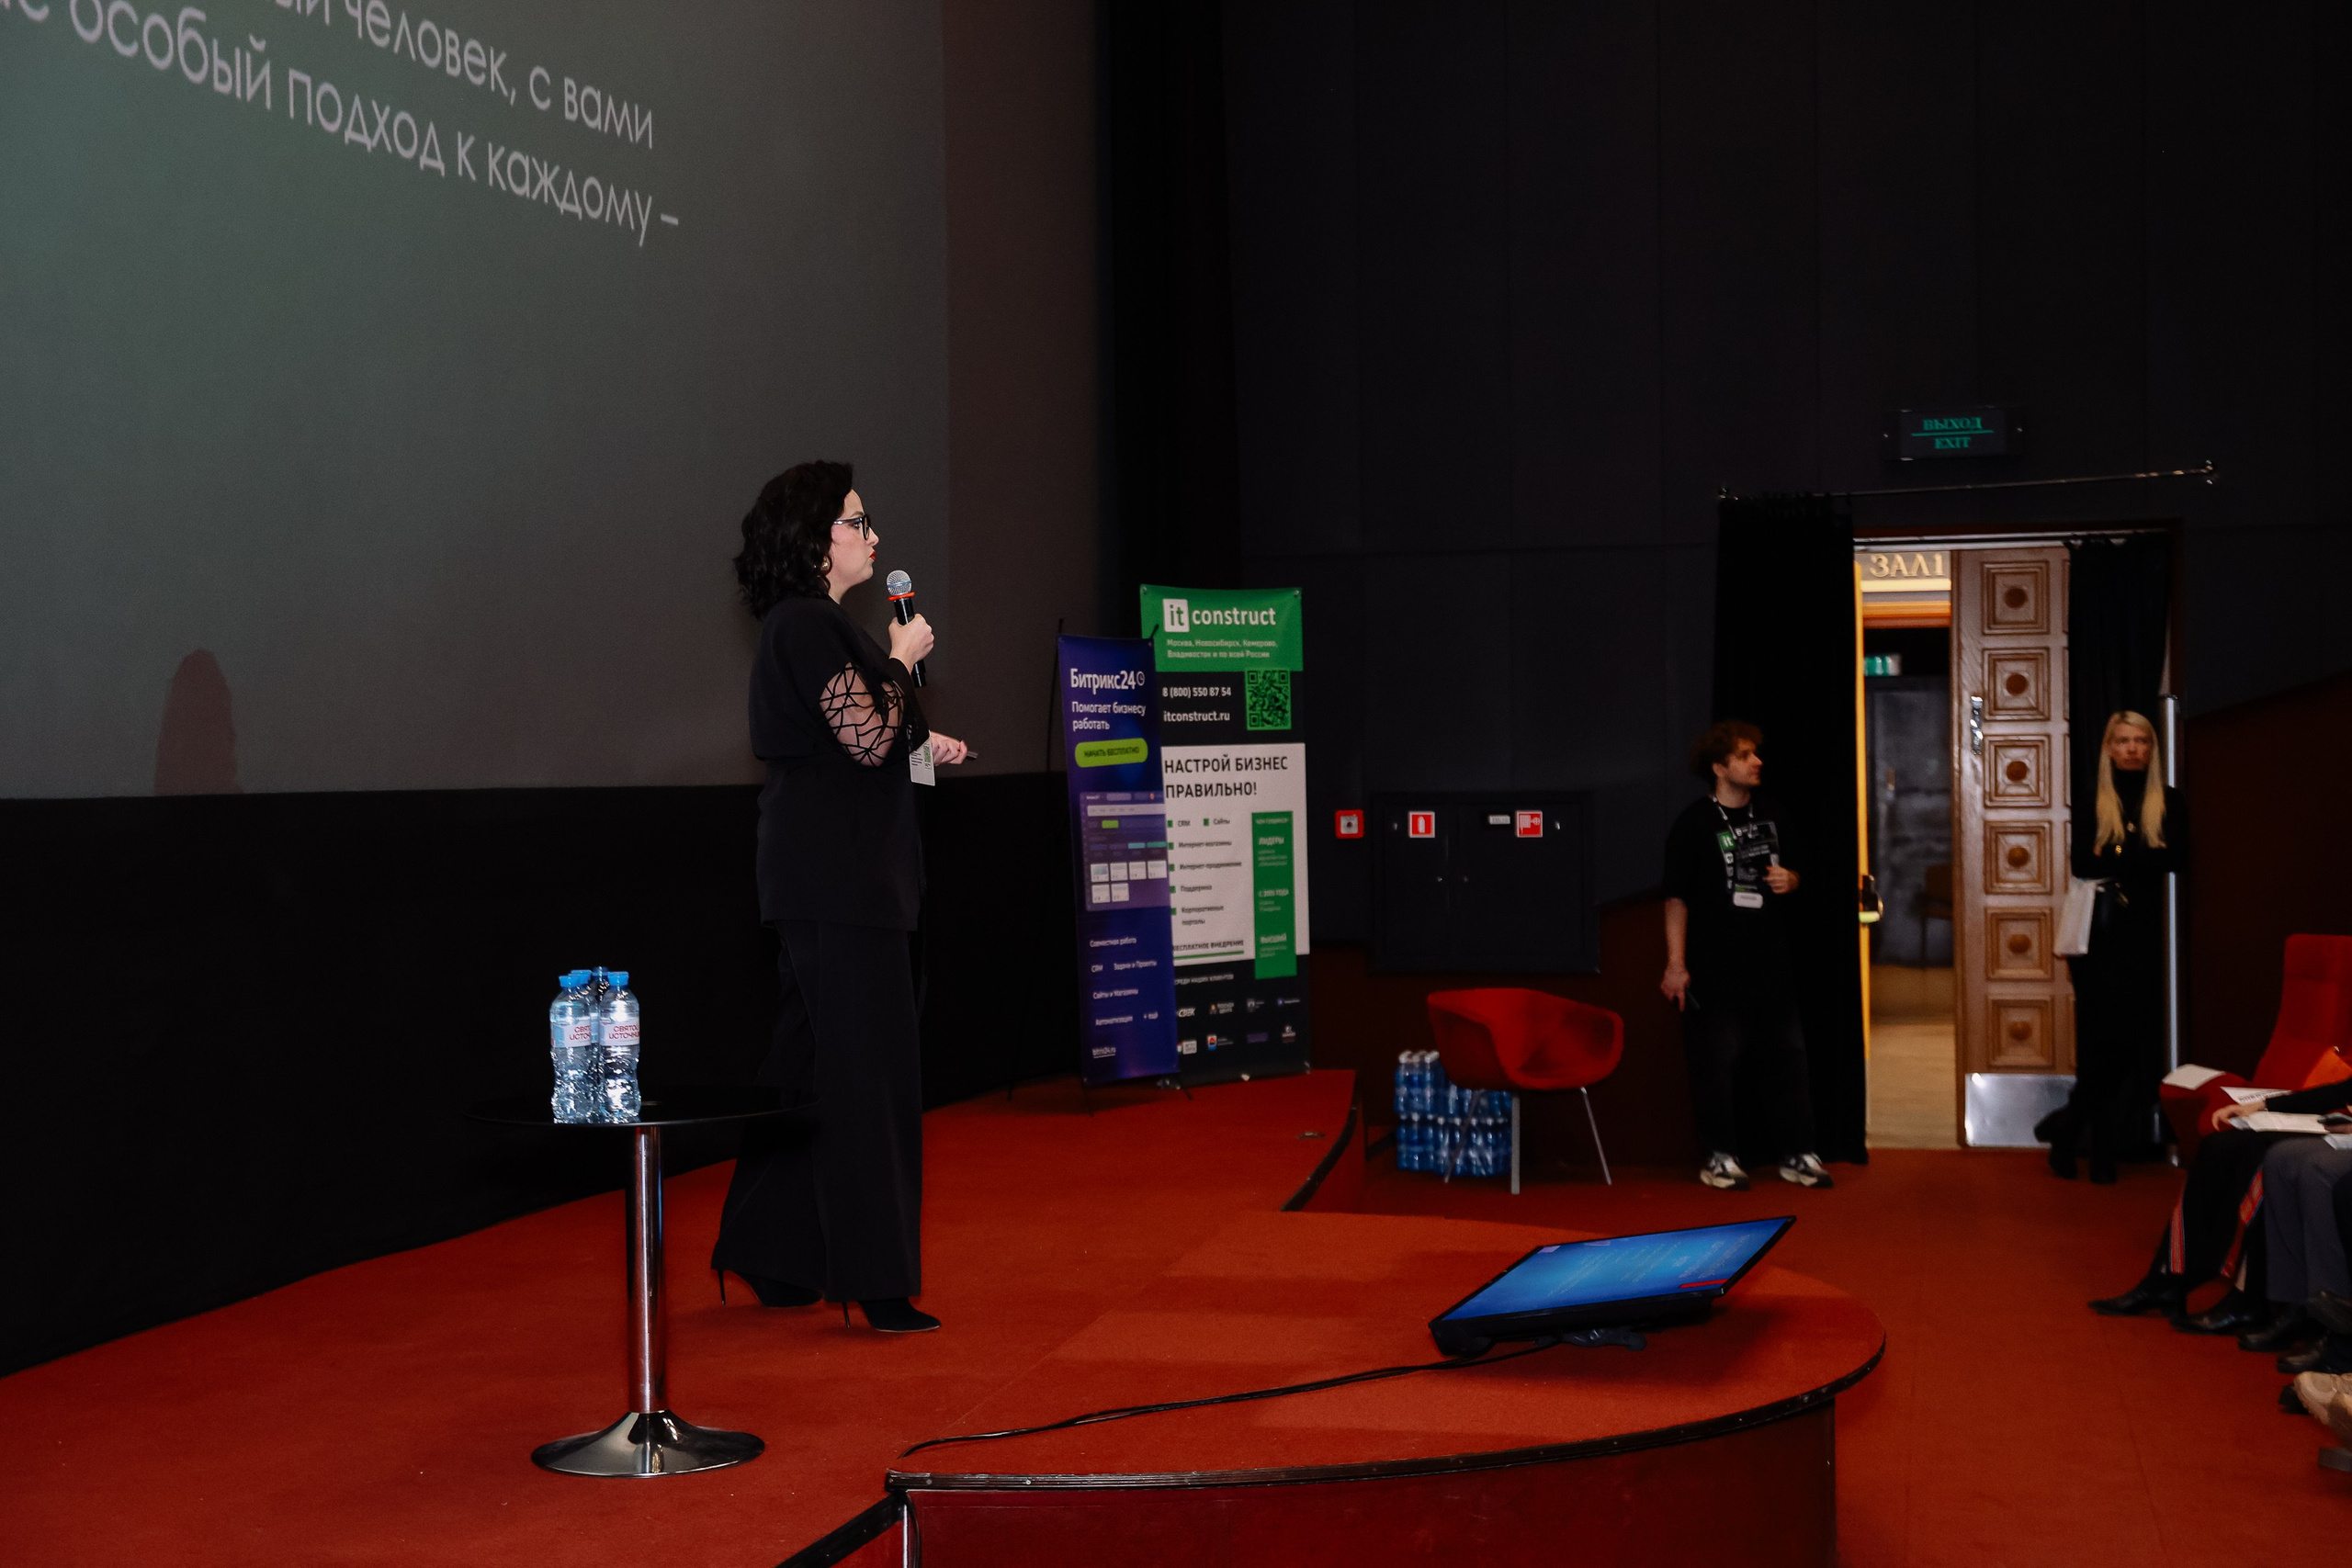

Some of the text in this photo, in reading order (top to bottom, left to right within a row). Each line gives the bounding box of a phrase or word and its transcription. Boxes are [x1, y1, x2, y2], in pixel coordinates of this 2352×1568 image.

[345, 0, 652, 150] человек, с вами
[70, 0, 271, 110] особый
[288, 68, 445, 176] подход
[458, 130, 476, 182] к
[487, 141, 652, 248] каждому
[1922, 416, 1982, 431] ВЫХОД
[1934, 436, 1972, 449] EXIT
[1170, 604, 1276, 626] it construct
[1070, 668, 1136, 695] Битрикс24
[1162, 686, 1231, 698] 8 (800) 550 87 54
[1072, 701, 1146, 716] Помогает бизнесу
[1163, 711, 1230, 722] itconstruct.ru
[1072, 717, 1110, 732] работать
[1164, 754, 1288, 773] НАСТРОЙ БИЗНЕС
[1165, 782, 1257, 798] ПРАВИЛЬНО!
